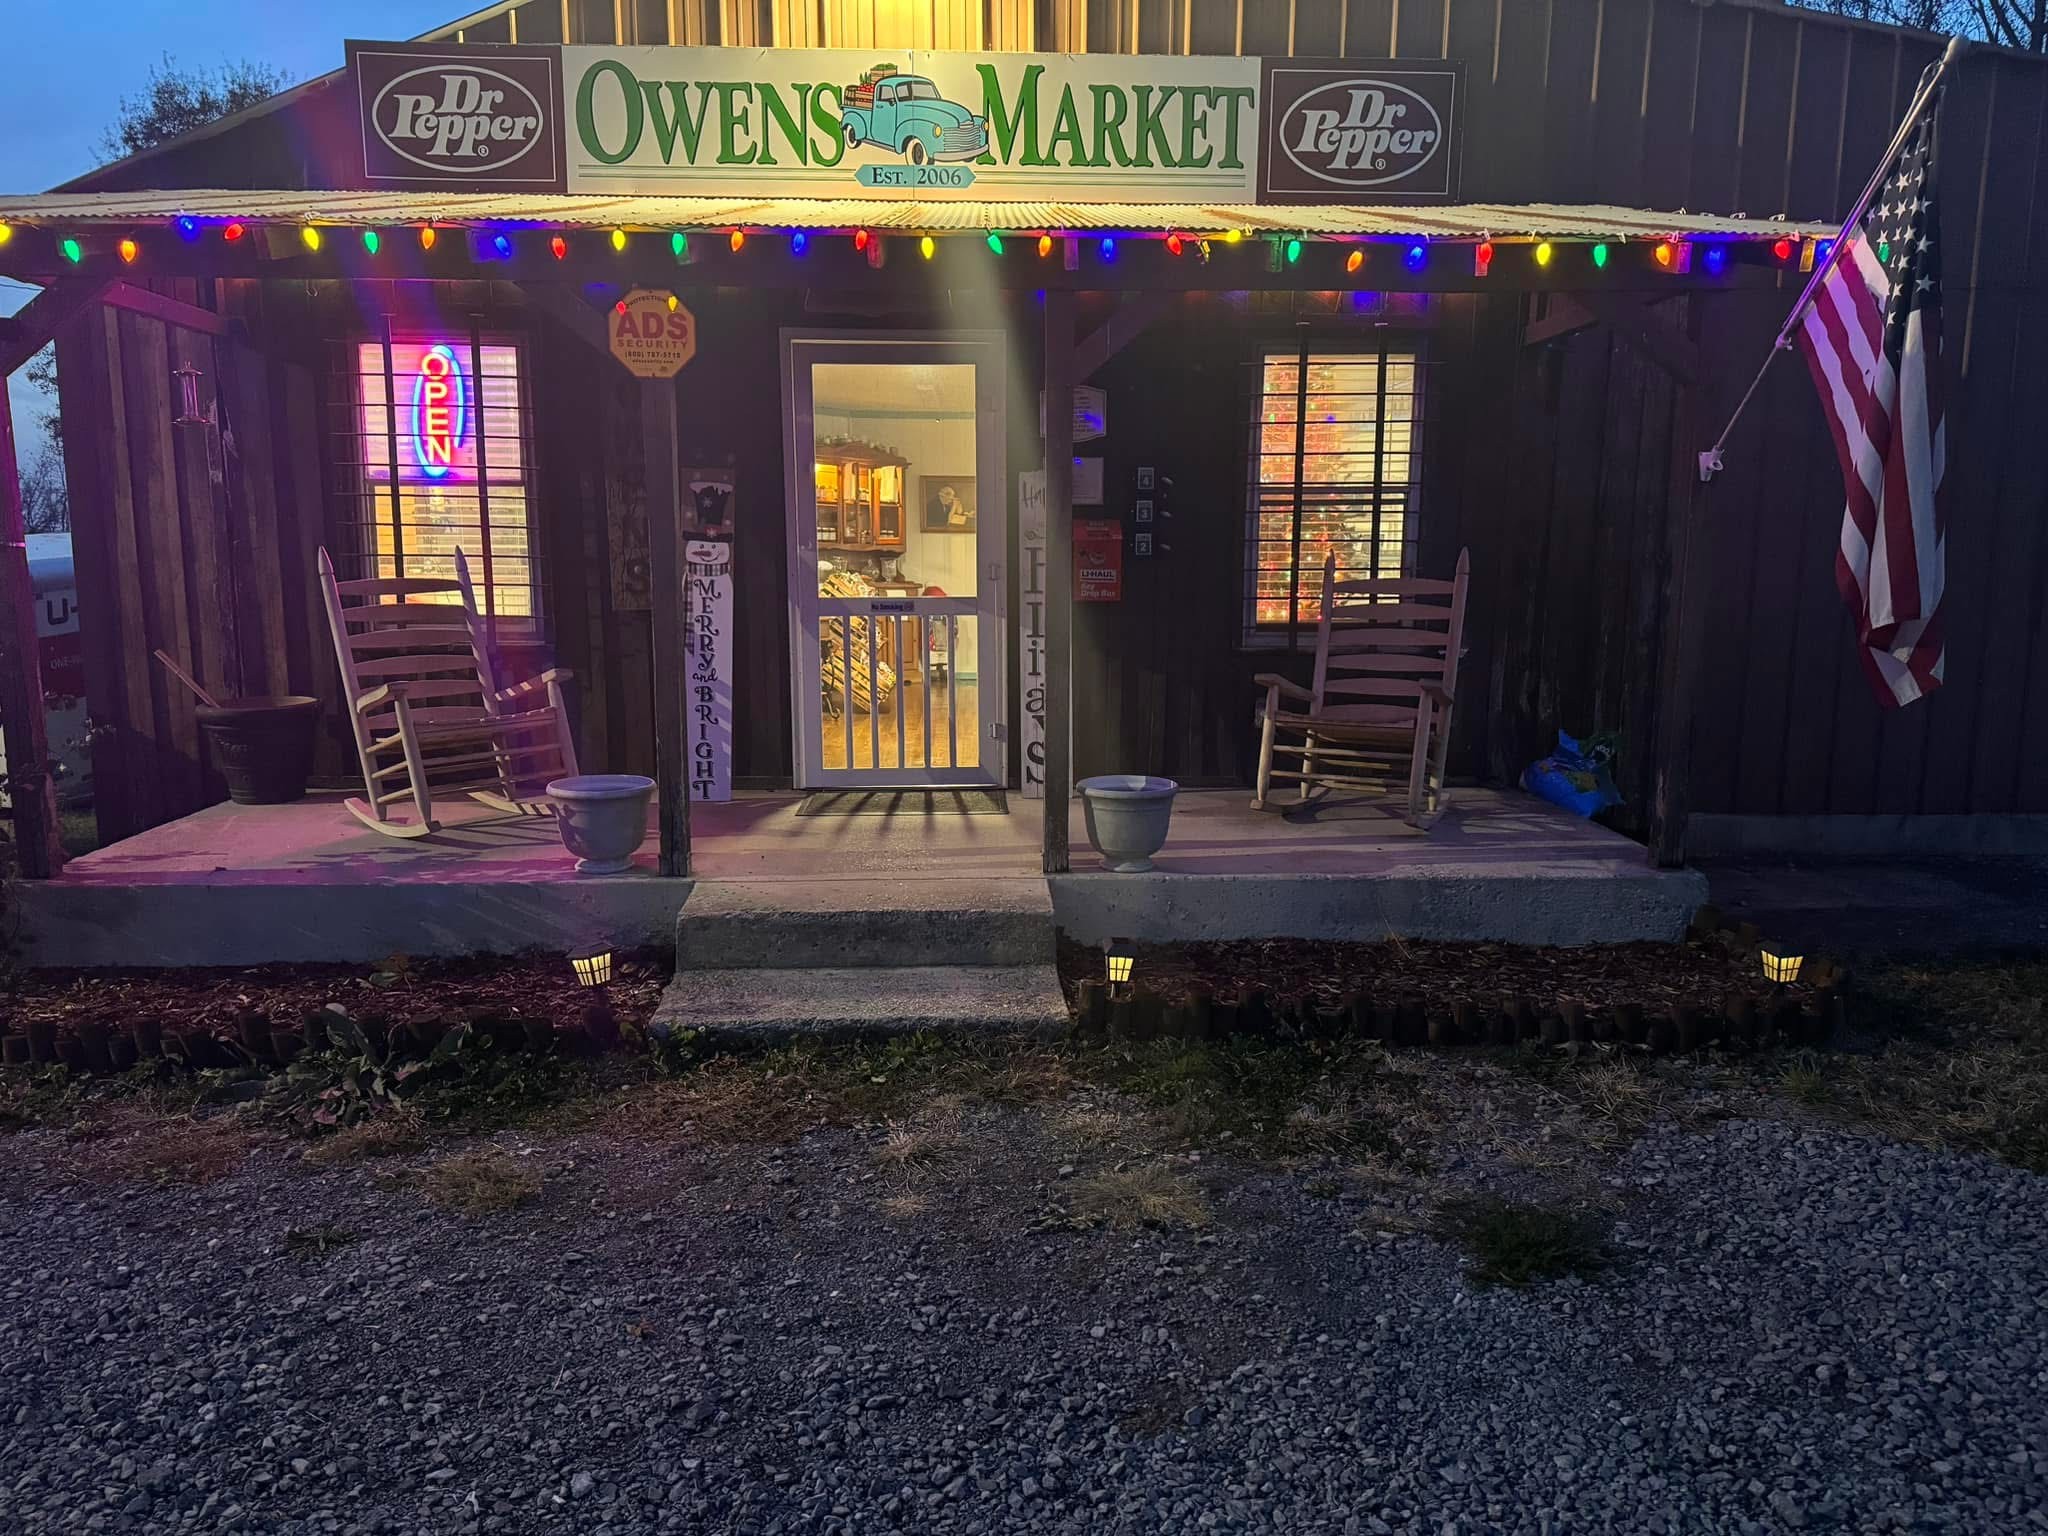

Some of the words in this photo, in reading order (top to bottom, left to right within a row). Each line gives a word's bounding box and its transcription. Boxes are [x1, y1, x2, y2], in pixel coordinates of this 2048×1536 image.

[435, 74, 505, 115] Dr
[1338, 89, 1407, 128] Dr
[388, 94, 537, 157] Pepper
[1291, 110, 1436, 169] Pepper
[917, 168, 962, 185] 2006
[615, 311, 689, 340] ADS
[616, 339, 688, 350] SECURITY
[421, 352, 452, 464] OPEN
[693, 578, 722, 671] MERRY
[692, 668, 718, 682] and
[692, 685, 719, 800] BRIGHT
